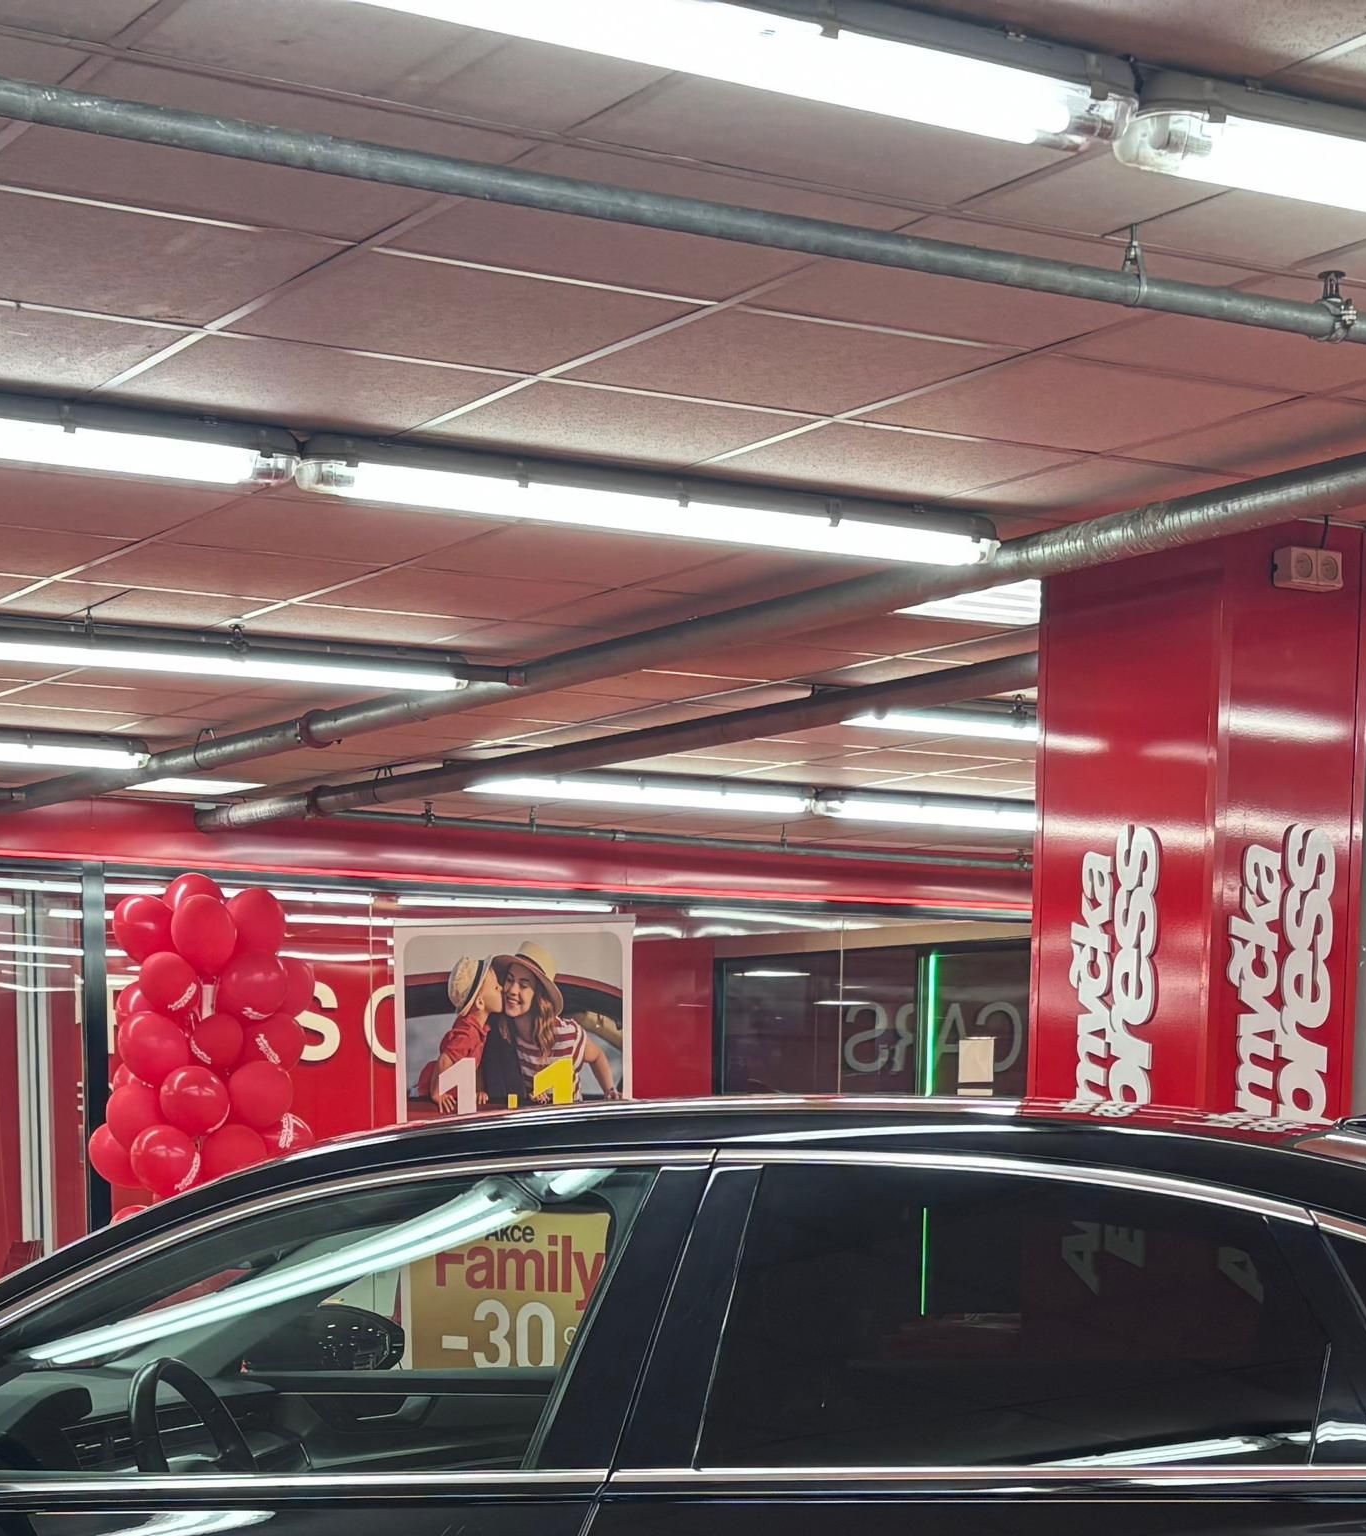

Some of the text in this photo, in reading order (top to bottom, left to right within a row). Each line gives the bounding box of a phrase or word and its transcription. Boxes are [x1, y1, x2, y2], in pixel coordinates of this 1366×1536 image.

[1070, 851, 1113, 1103] myčka
[1108, 824, 1160, 1104] press
[1227, 844, 1282, 1117] myčka
[1277, 823, 1335, 1124] press
[435, 1234, 605, 1311] Family
